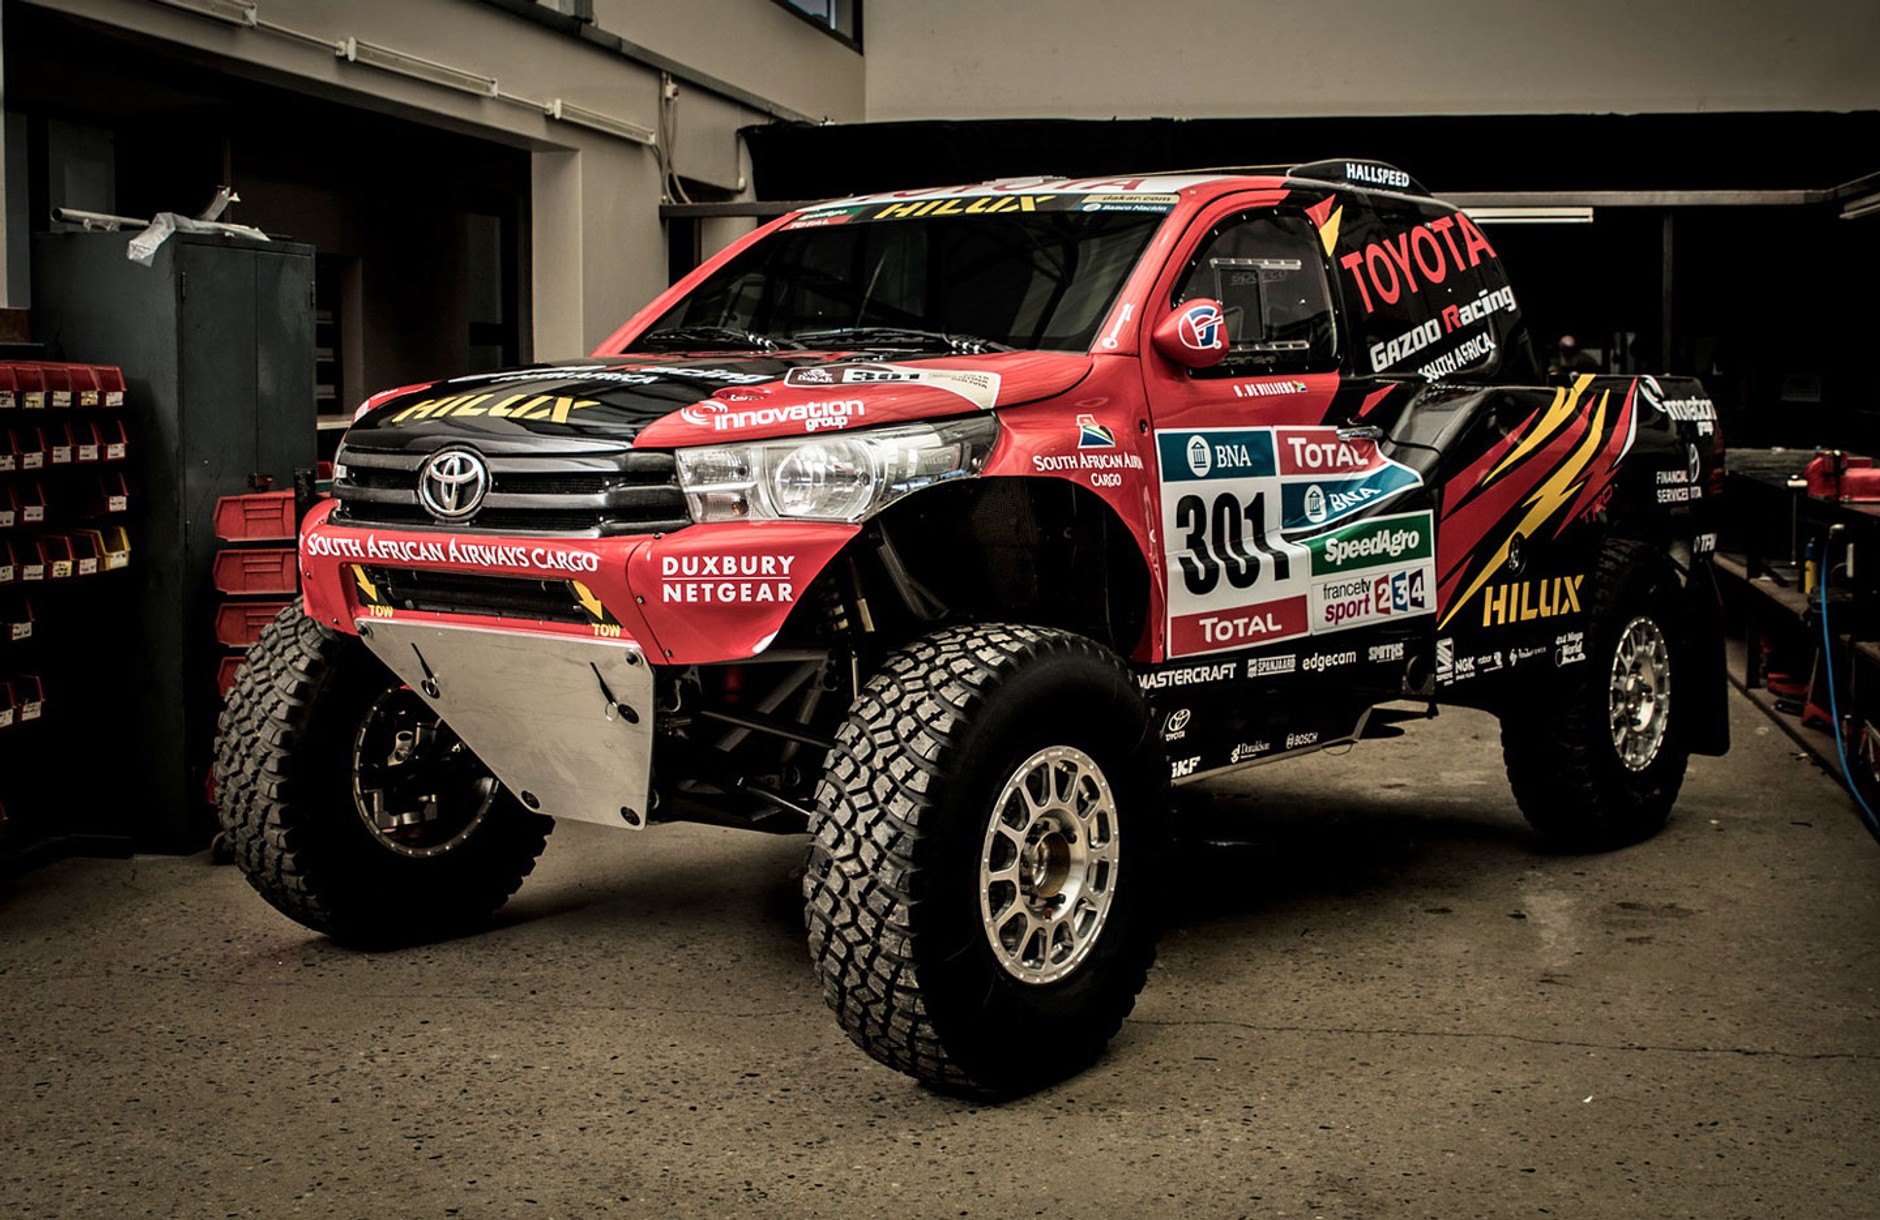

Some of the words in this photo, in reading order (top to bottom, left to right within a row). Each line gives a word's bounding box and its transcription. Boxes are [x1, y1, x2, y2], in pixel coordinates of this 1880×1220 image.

[1346, 163, 1410, 187] HALLSPEED
[873, 195, 1056, 219] HILUX
[1340, 212, 1497, 314] TOYOTA
[1369, 318, 1442, 373] GAZOO
[1441, 285, 1517, 334] Racing
[1418, 352, 1457, 383] SOUTH
[1454, 332, 1496, 367] AFRICA
[391, 394, 600, 423] HILUX
[714, 400, 865, 431] innovation
[805, 417, 848, 431] group
[1032, 455, 1079, 472] SOUTH
[1080, 451, 1121, 470] AFRICAN
[1215, 445, 1252, 468] BNA
[1287, 437, 1369, 468] TOTAL
[1091, 473, 1122, 487] CARGO
[1656, 469, 1689, 485] FINANCIAL
[1329, 487, 1381, 512] BNA
[1656, 487, 1689, 503] SERVICES
[307, 532, 365, 558] SOUTH
[367, 534, 446, 563] AFRICAN
[449, 538, 531, 567] AIRWAYS
[531, 547, 601, 572] CARGO
[1176, 492, 1290, 595] 301
[1324, 530, 1420, 565] SpeedAgro
[662, 556, 795, 575] DUXBURY
[663, 583, 793, 602] NETGEAR
[1323, 579, 1371, 600] francetv
[1482, 574, 1584, 627] HILUX
[368, 604, 394, 618] TOW
[1324, 593, 1370, 625] sport
[591, 622, 622, 637] TOW
[1199, 613, 1282, 643] TOTAL
[1302, 651, 1357, 672] edgecam
[1455, 656, 1475, 674] NGK
[1137, 662, 1237, 689] MASTERCRAFT
[1294, 732, 1319, 746] BOSCH
